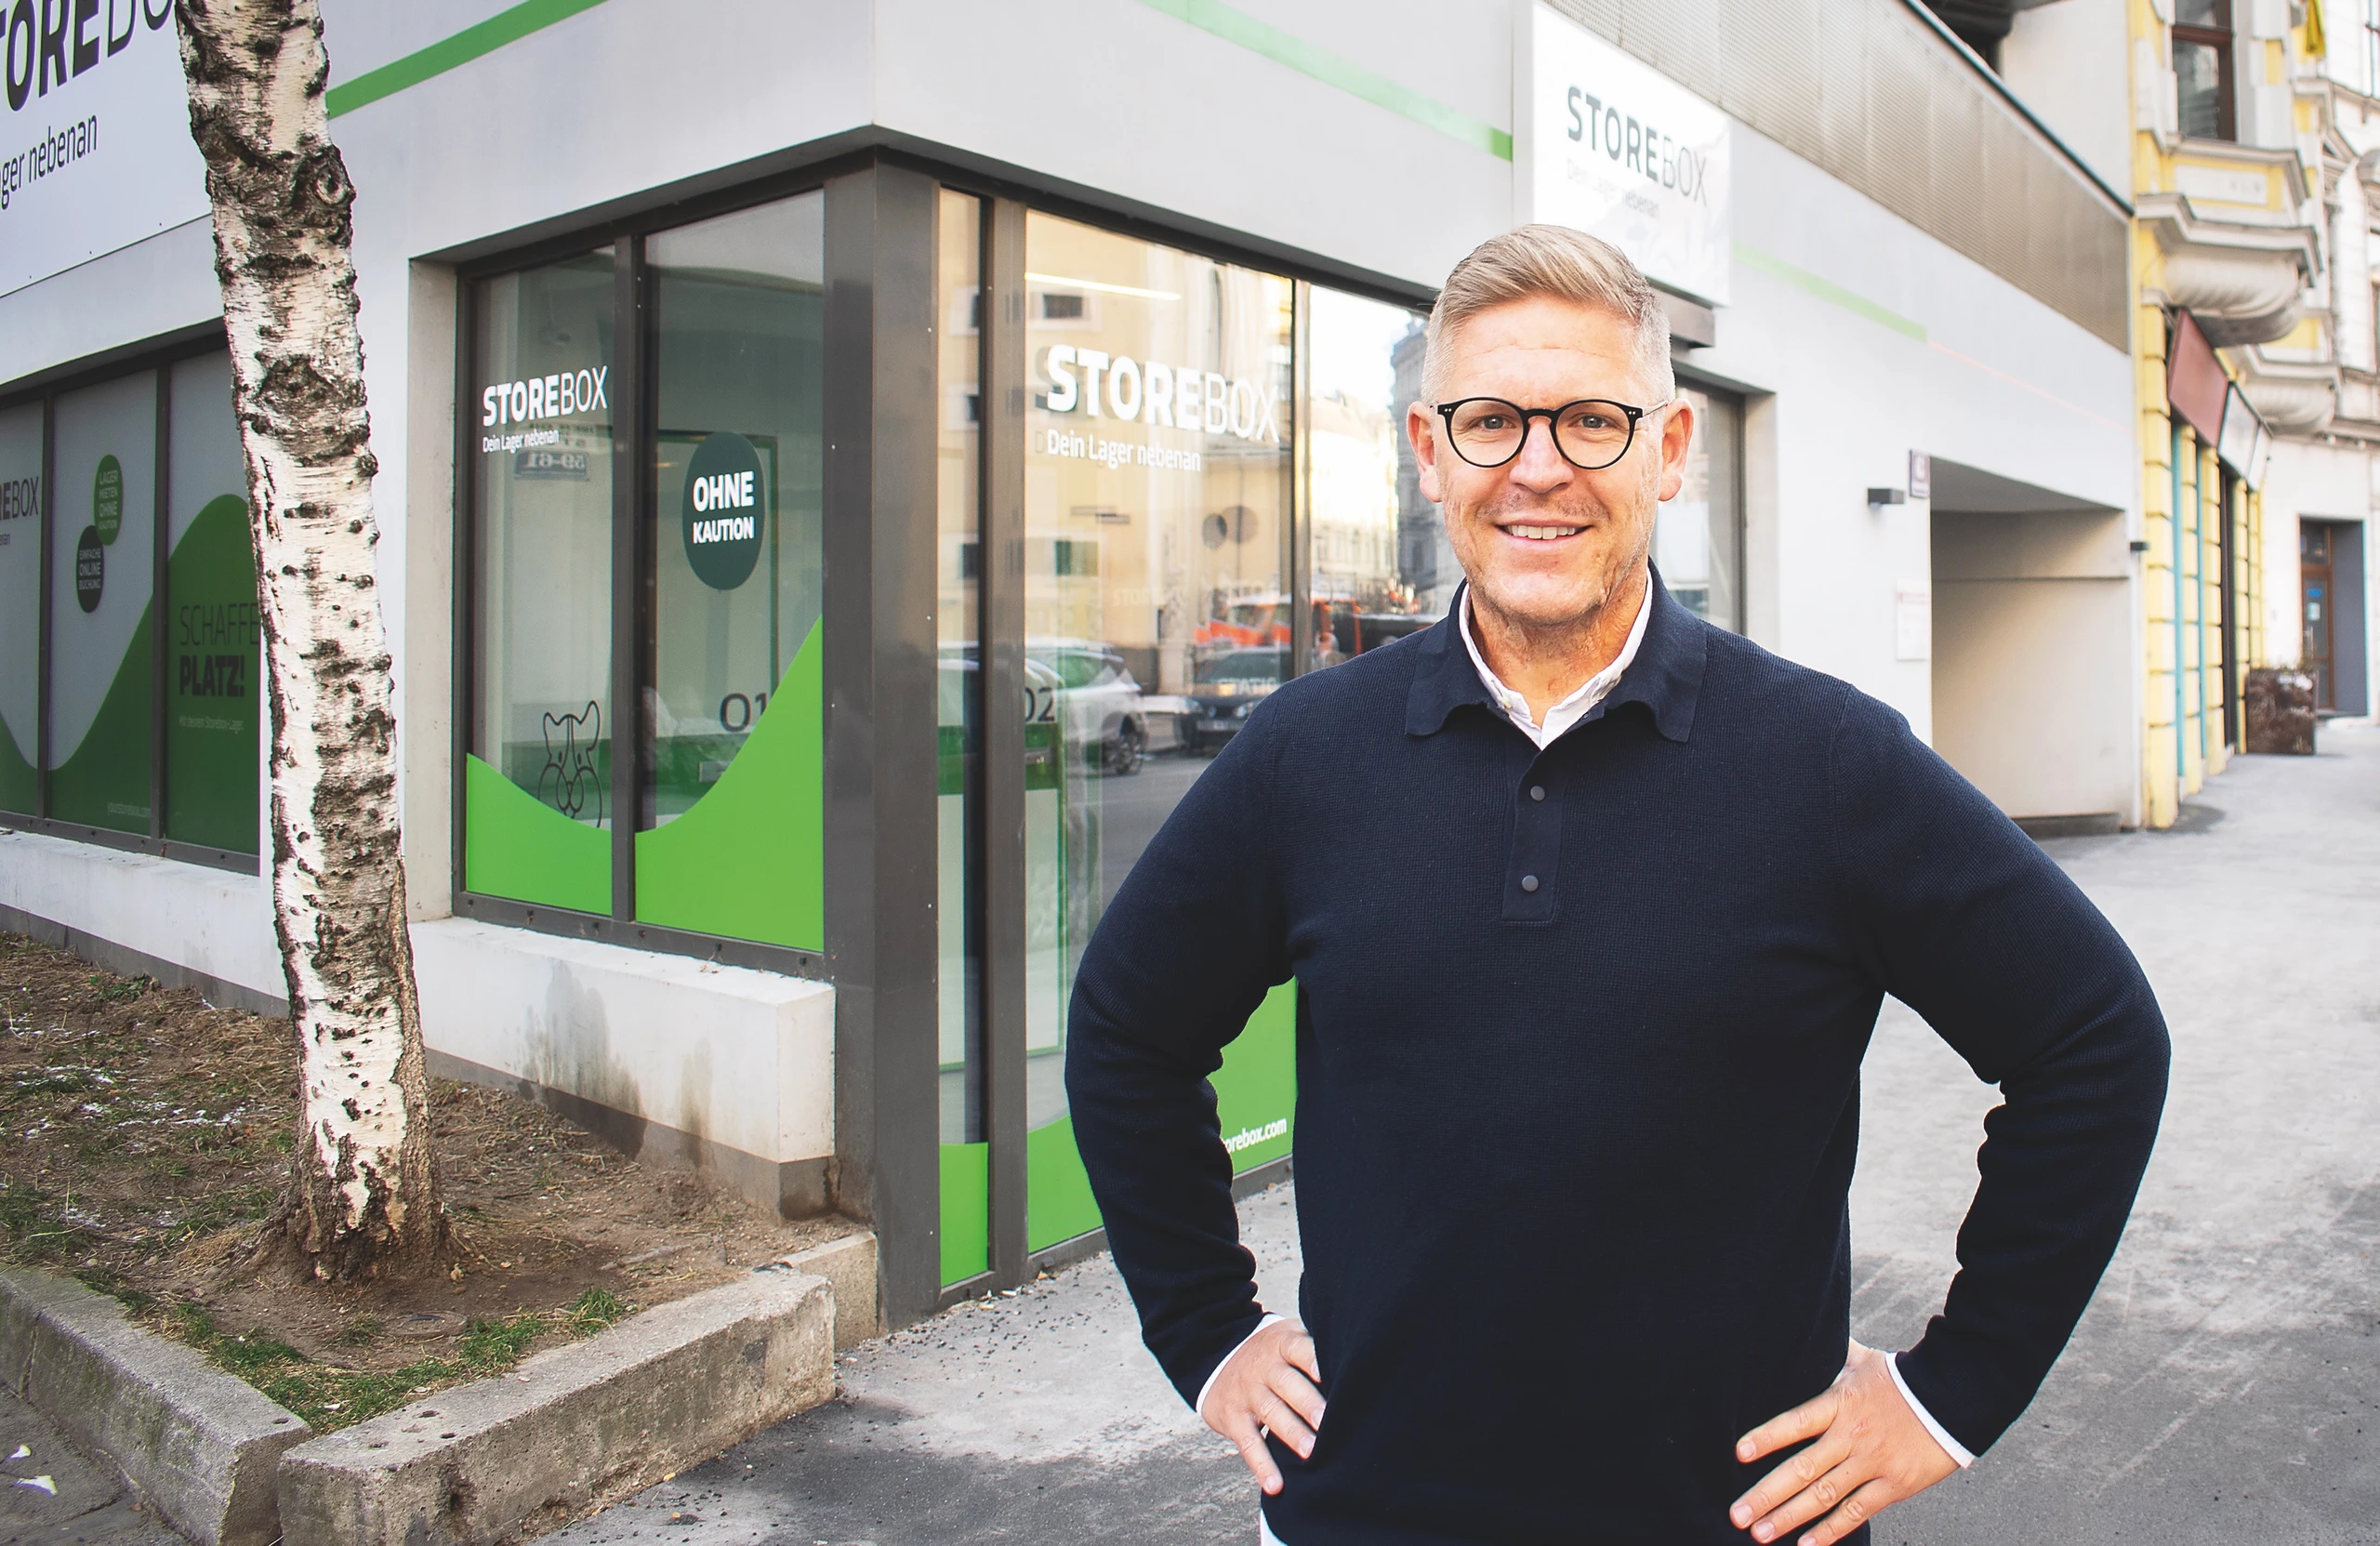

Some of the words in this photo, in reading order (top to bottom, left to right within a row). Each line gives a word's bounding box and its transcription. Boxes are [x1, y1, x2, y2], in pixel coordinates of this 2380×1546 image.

[0, 152, 25, 210] ger
[29, 114, 98, 183] nebenan
[1567, 85, 1707, 206] STOREBOX
[483, 365, 608, 427] STOREBOX
[1047, 344, 1279, 443] STOREBOX
[483, 434, 501, 453] Dein
[502, 432, 523, 454] Lager
[524, 429, 560, 448] nebenan
[1047, 429, 1085, 458] Dein
[1089, 435, 1133, 469] Lager
[1137, 443, 1201, 471] nebenan
[99, 469, 118, 484] LAGER
[693, 470, 755, 511] OHNE
[0, 476, 39, 521] EBOX
[99, 500, 118, 517] OHNE
[693, 516, 755, 543] KAUTION
[79, 562, 101, 576] ONLINE
[179, 654, 245, 697] PLATZ!
[1221, 1118, 1287, 1154] orebox.com
